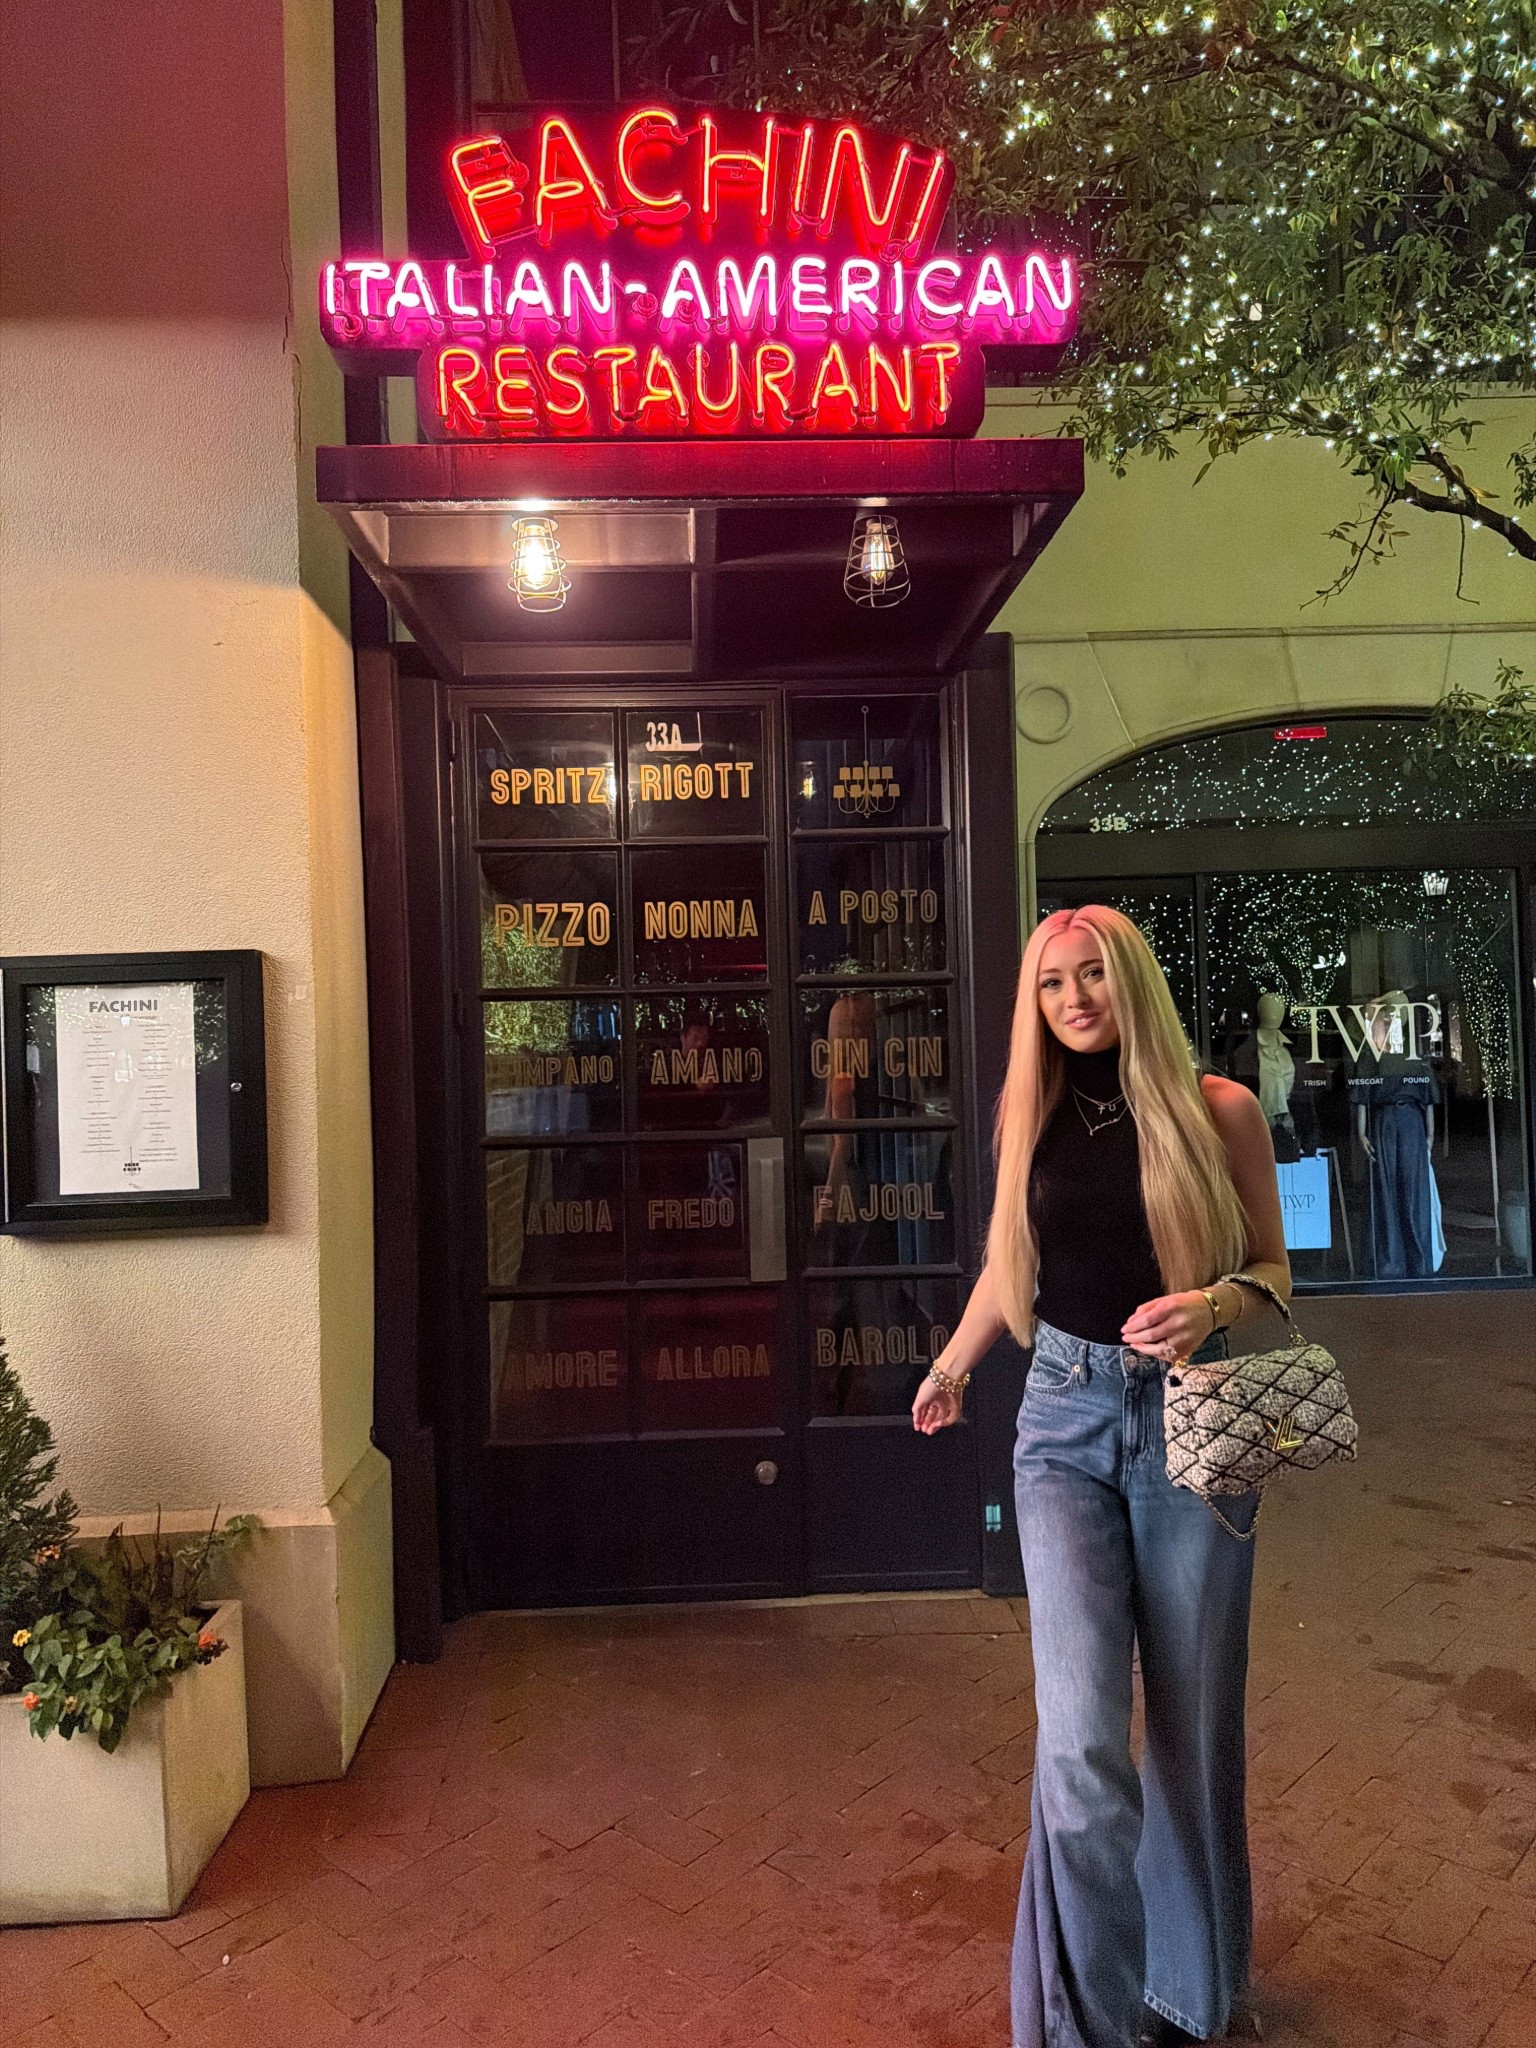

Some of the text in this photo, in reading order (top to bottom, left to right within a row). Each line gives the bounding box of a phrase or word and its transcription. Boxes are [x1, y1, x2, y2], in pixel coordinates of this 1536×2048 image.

[449, 107, 948, 256] FACHINI
[325, 256, 1073, 326] ITALIAN-AMERICAN
[437, 342, 961, 422] RESTAURANT
[645, 721, 683, 752] 33A
[490, 767, 608, 805] SPRITZ
[639, 761, 754, 801] RIGOTT
[1088, 816, 1128, 833] 33B
[494, 902, 611, 948] PIZZO
[644, 899, 759, 940] NONNA
[808, 888, 938, 926] A POSTO
[89, 999, 158, 1013] FACHINI
[1290, 1002, 1440, 1064] TWP
[650, 1047, 763, 1085] AMANO
[810, 1036, 943, 1079] CIN CIN
[1303, 1076, 1430, 1087] TRISH WESCOAT POUND
[648, 1197, 735, 1230] FREDO
[1280, 1193, 1315, 1210] TWP
[656, 1343, 771, 1381] ALLORA
